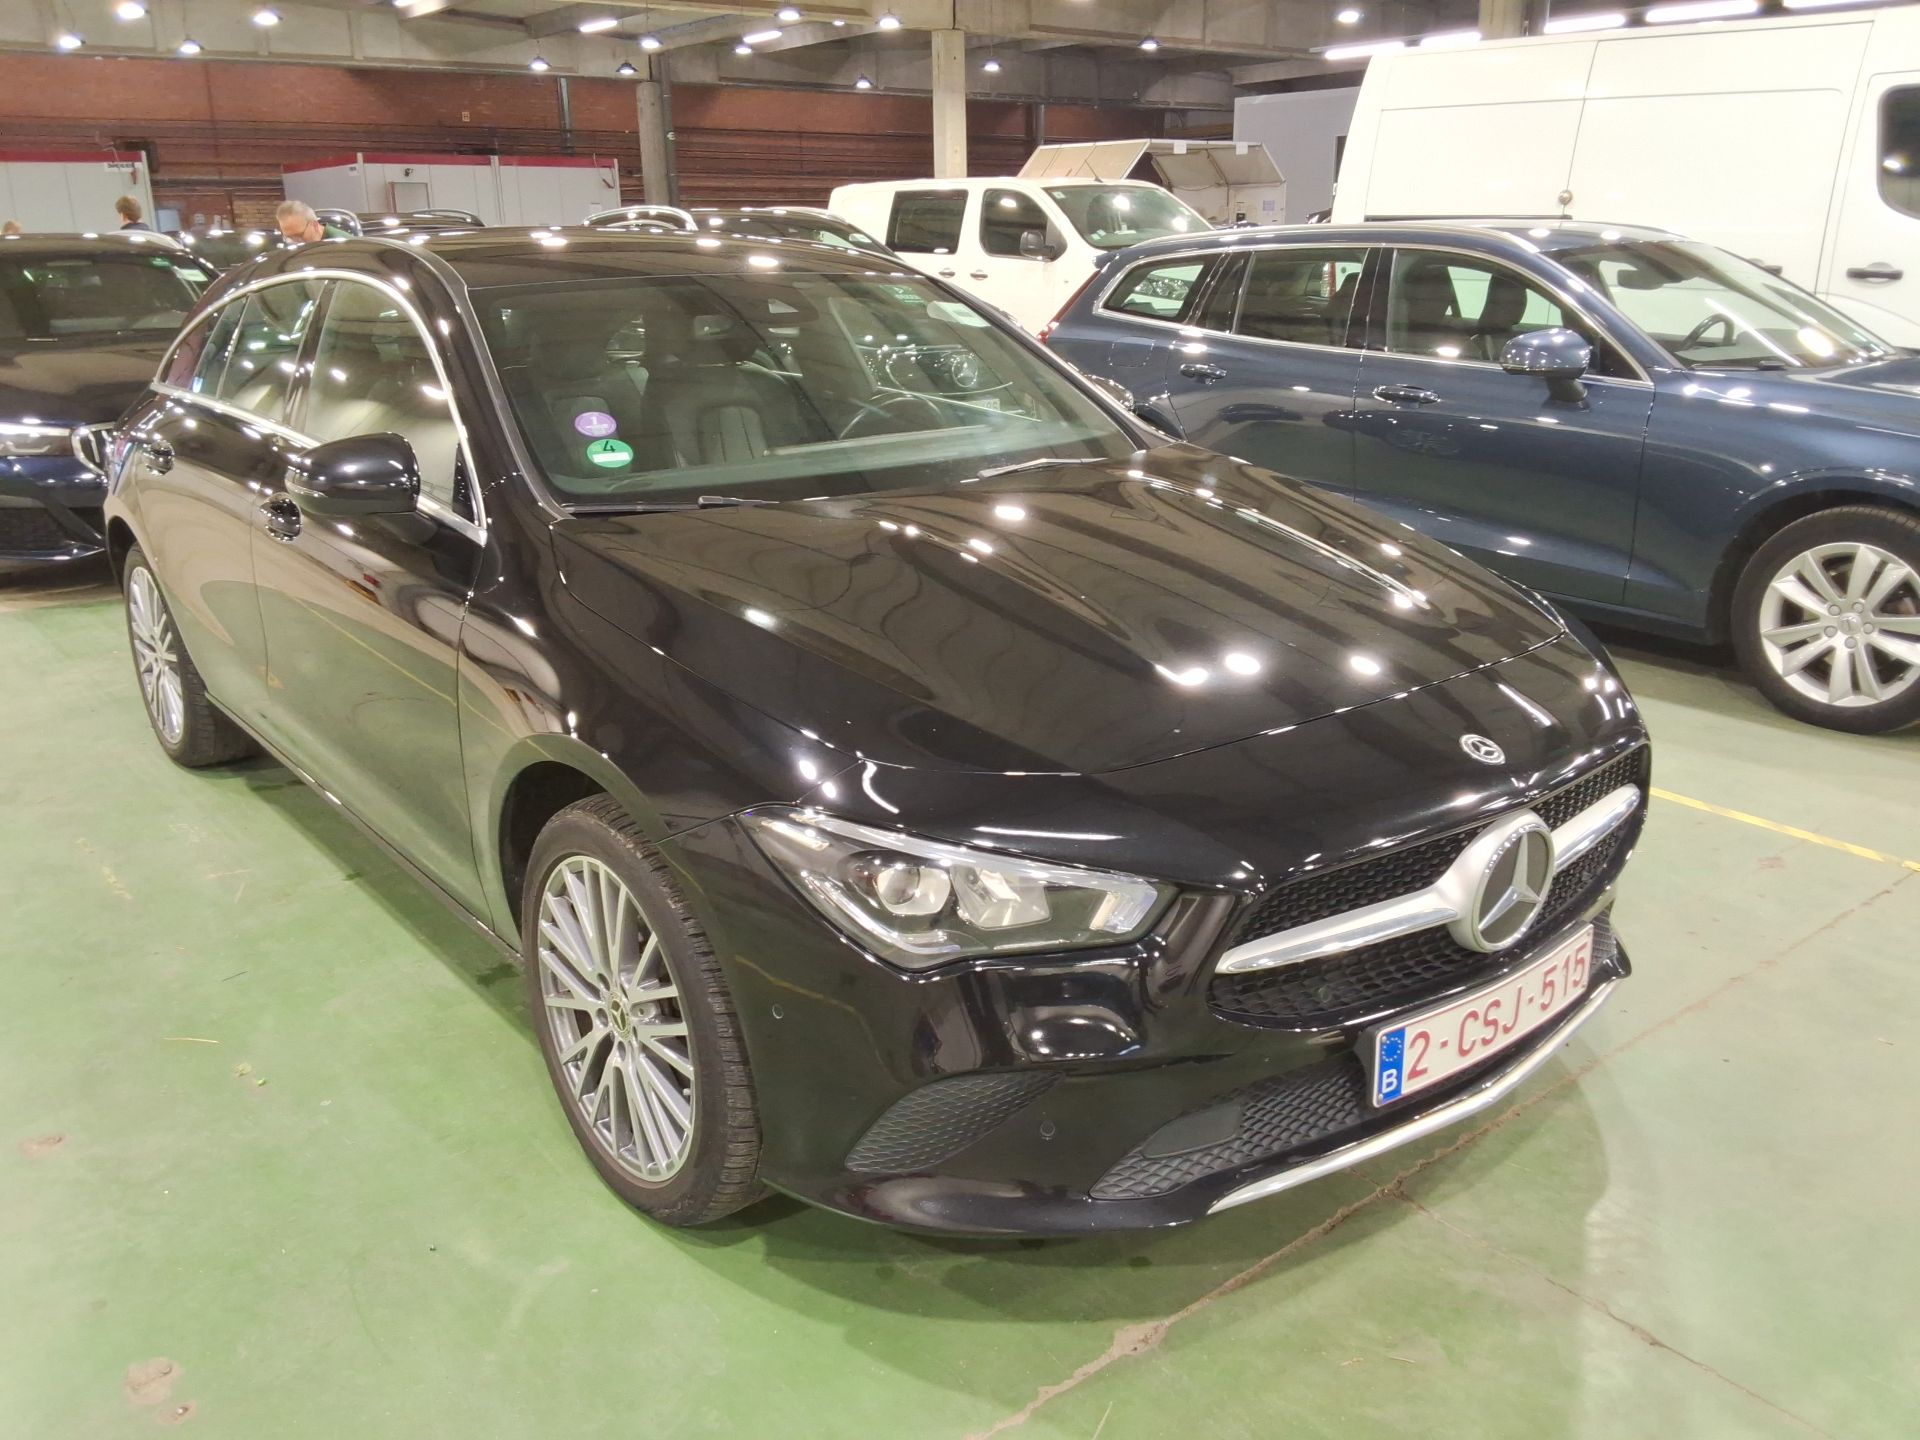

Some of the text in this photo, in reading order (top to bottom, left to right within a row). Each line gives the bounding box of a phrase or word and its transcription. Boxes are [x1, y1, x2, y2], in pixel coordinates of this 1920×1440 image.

[603, 440, 616, 452] 4
[1406, 942, 1589, 1081] 2-CSJ-515
[1381, 1068, 1398, 1094] B
